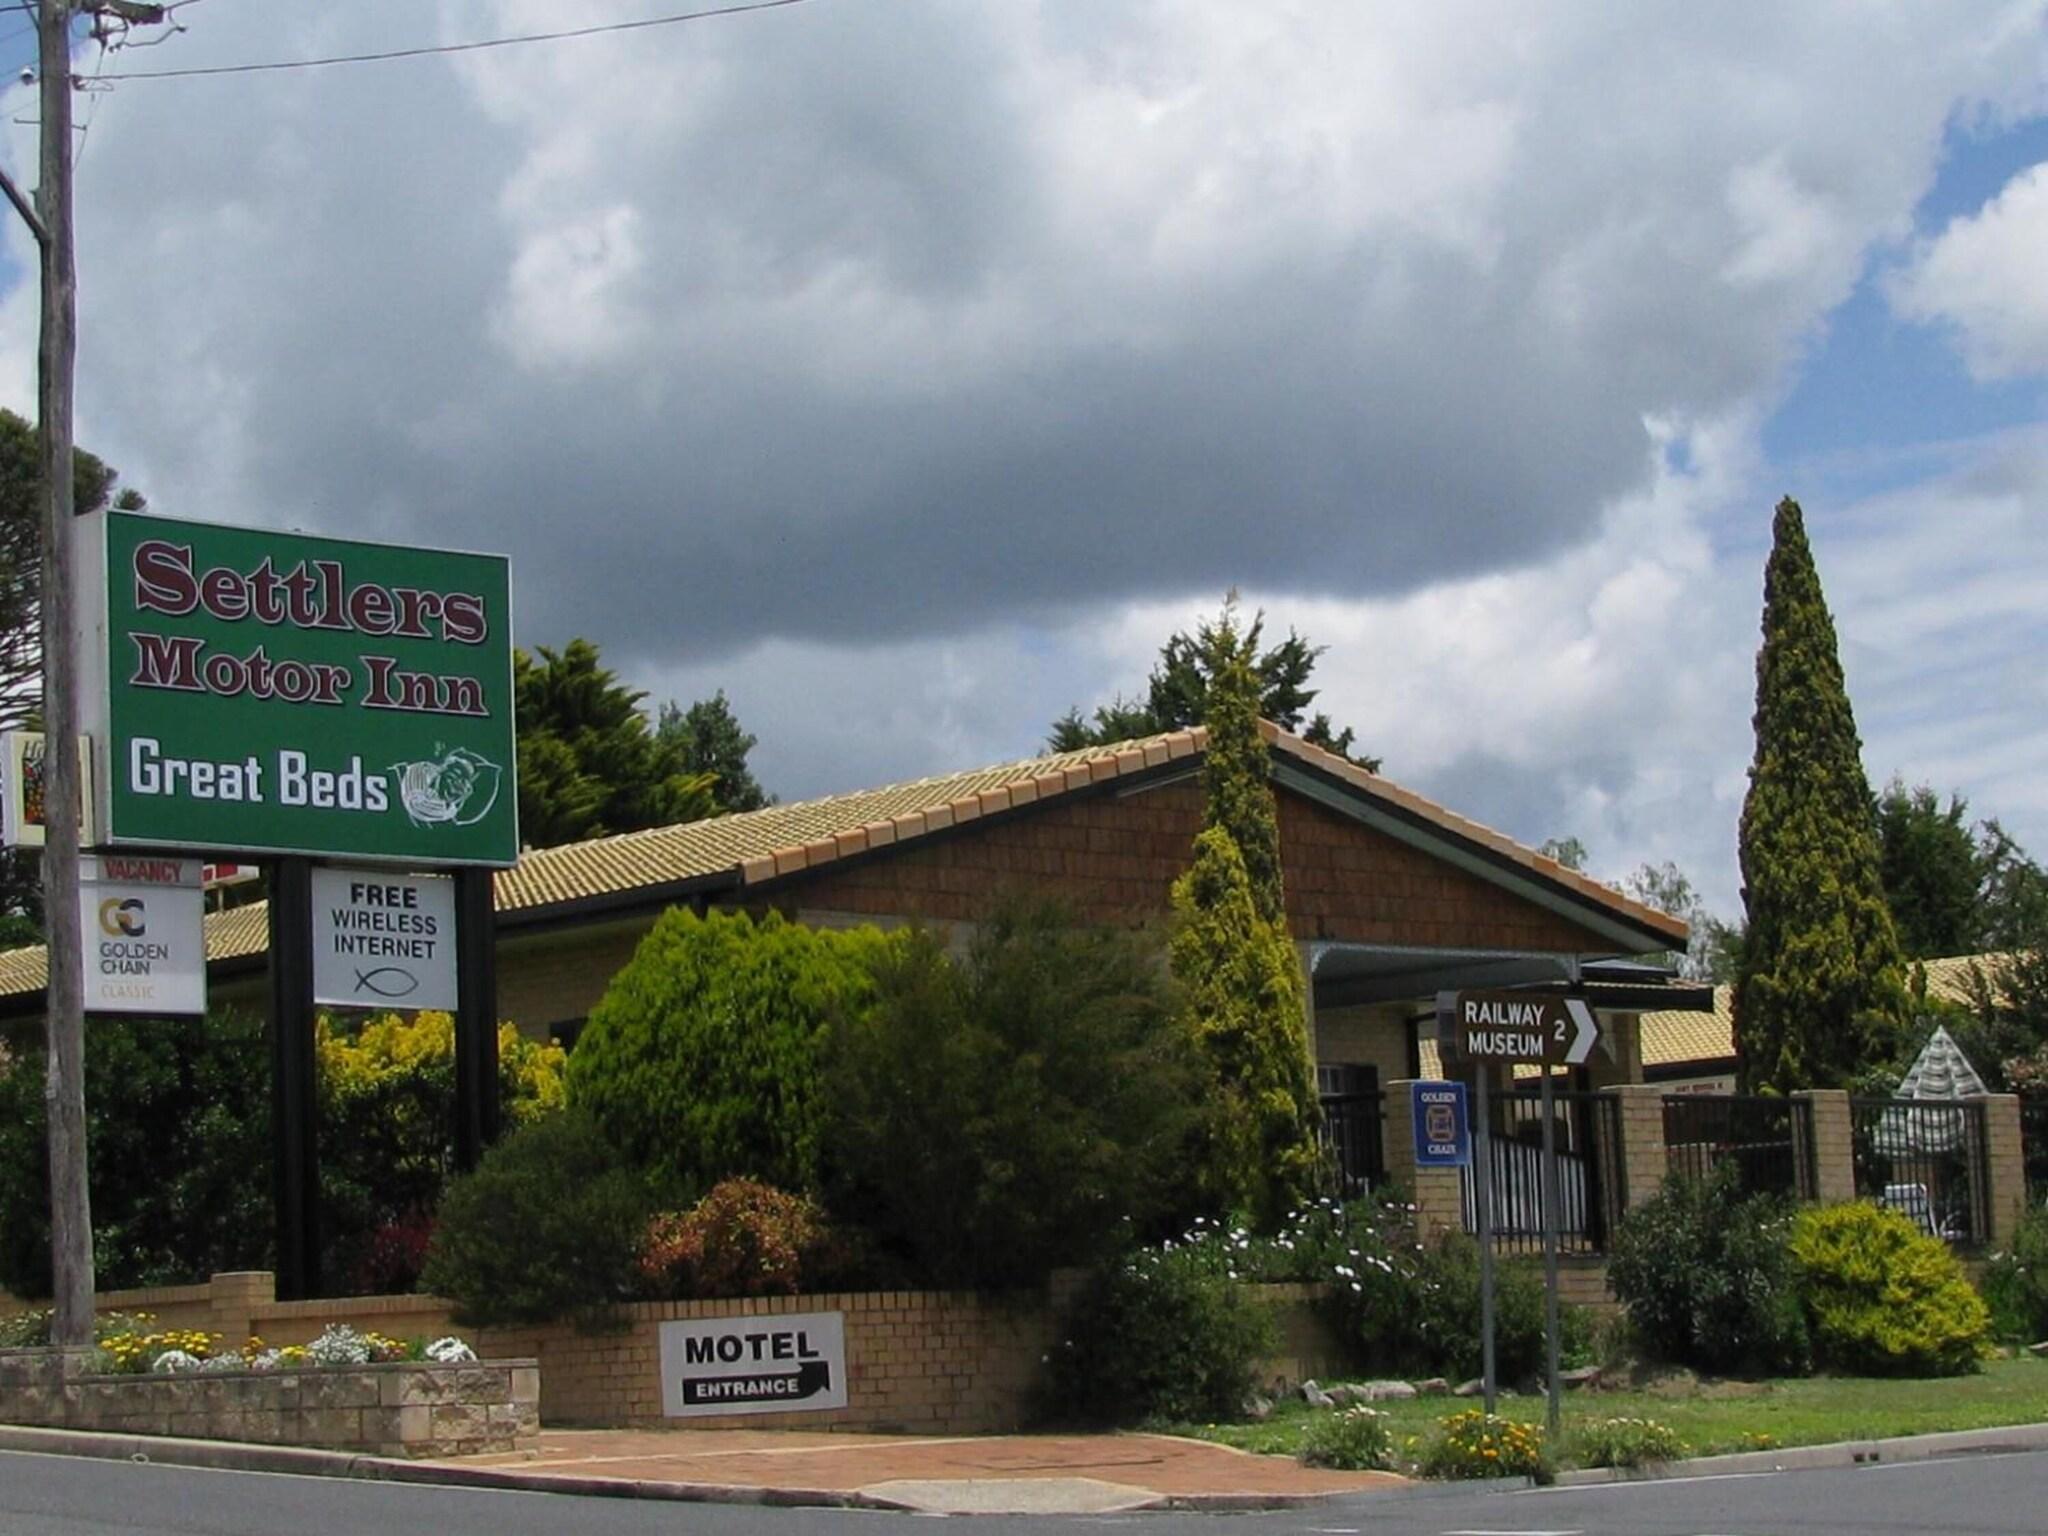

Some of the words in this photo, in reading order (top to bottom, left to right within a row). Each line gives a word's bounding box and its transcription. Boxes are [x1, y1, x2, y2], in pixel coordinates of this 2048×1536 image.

[133, 540, 487, 644] Settlers
[128, 632, 352, 704] Motor
[359, 655, 490, 716] Inn
[130, 737, 263, 802] Great
[279, 749, 389, 812] Beds
[104, 857, 184, 882] VACANCY
[351, 883, 418, 908] FREE
[332, 909, 437, 935] WIRELESS
[100, 942, 168, 960] GOLDEN
[334, 934, 436, 960] INTERNET
[100, 960, 151, 975] CHAIN
[101, 984, 155, 999] CLASSIC
[1465, 1001, 1545, 1027] RAILWAY
[1554, 1019, 1566, 1041] 2
[1468, 1031, 1544, 1056] MUSEUM
[685, 1331, 819, 1364] MOTEL
[696, 1378, 799, 1398] ENTRANCE
